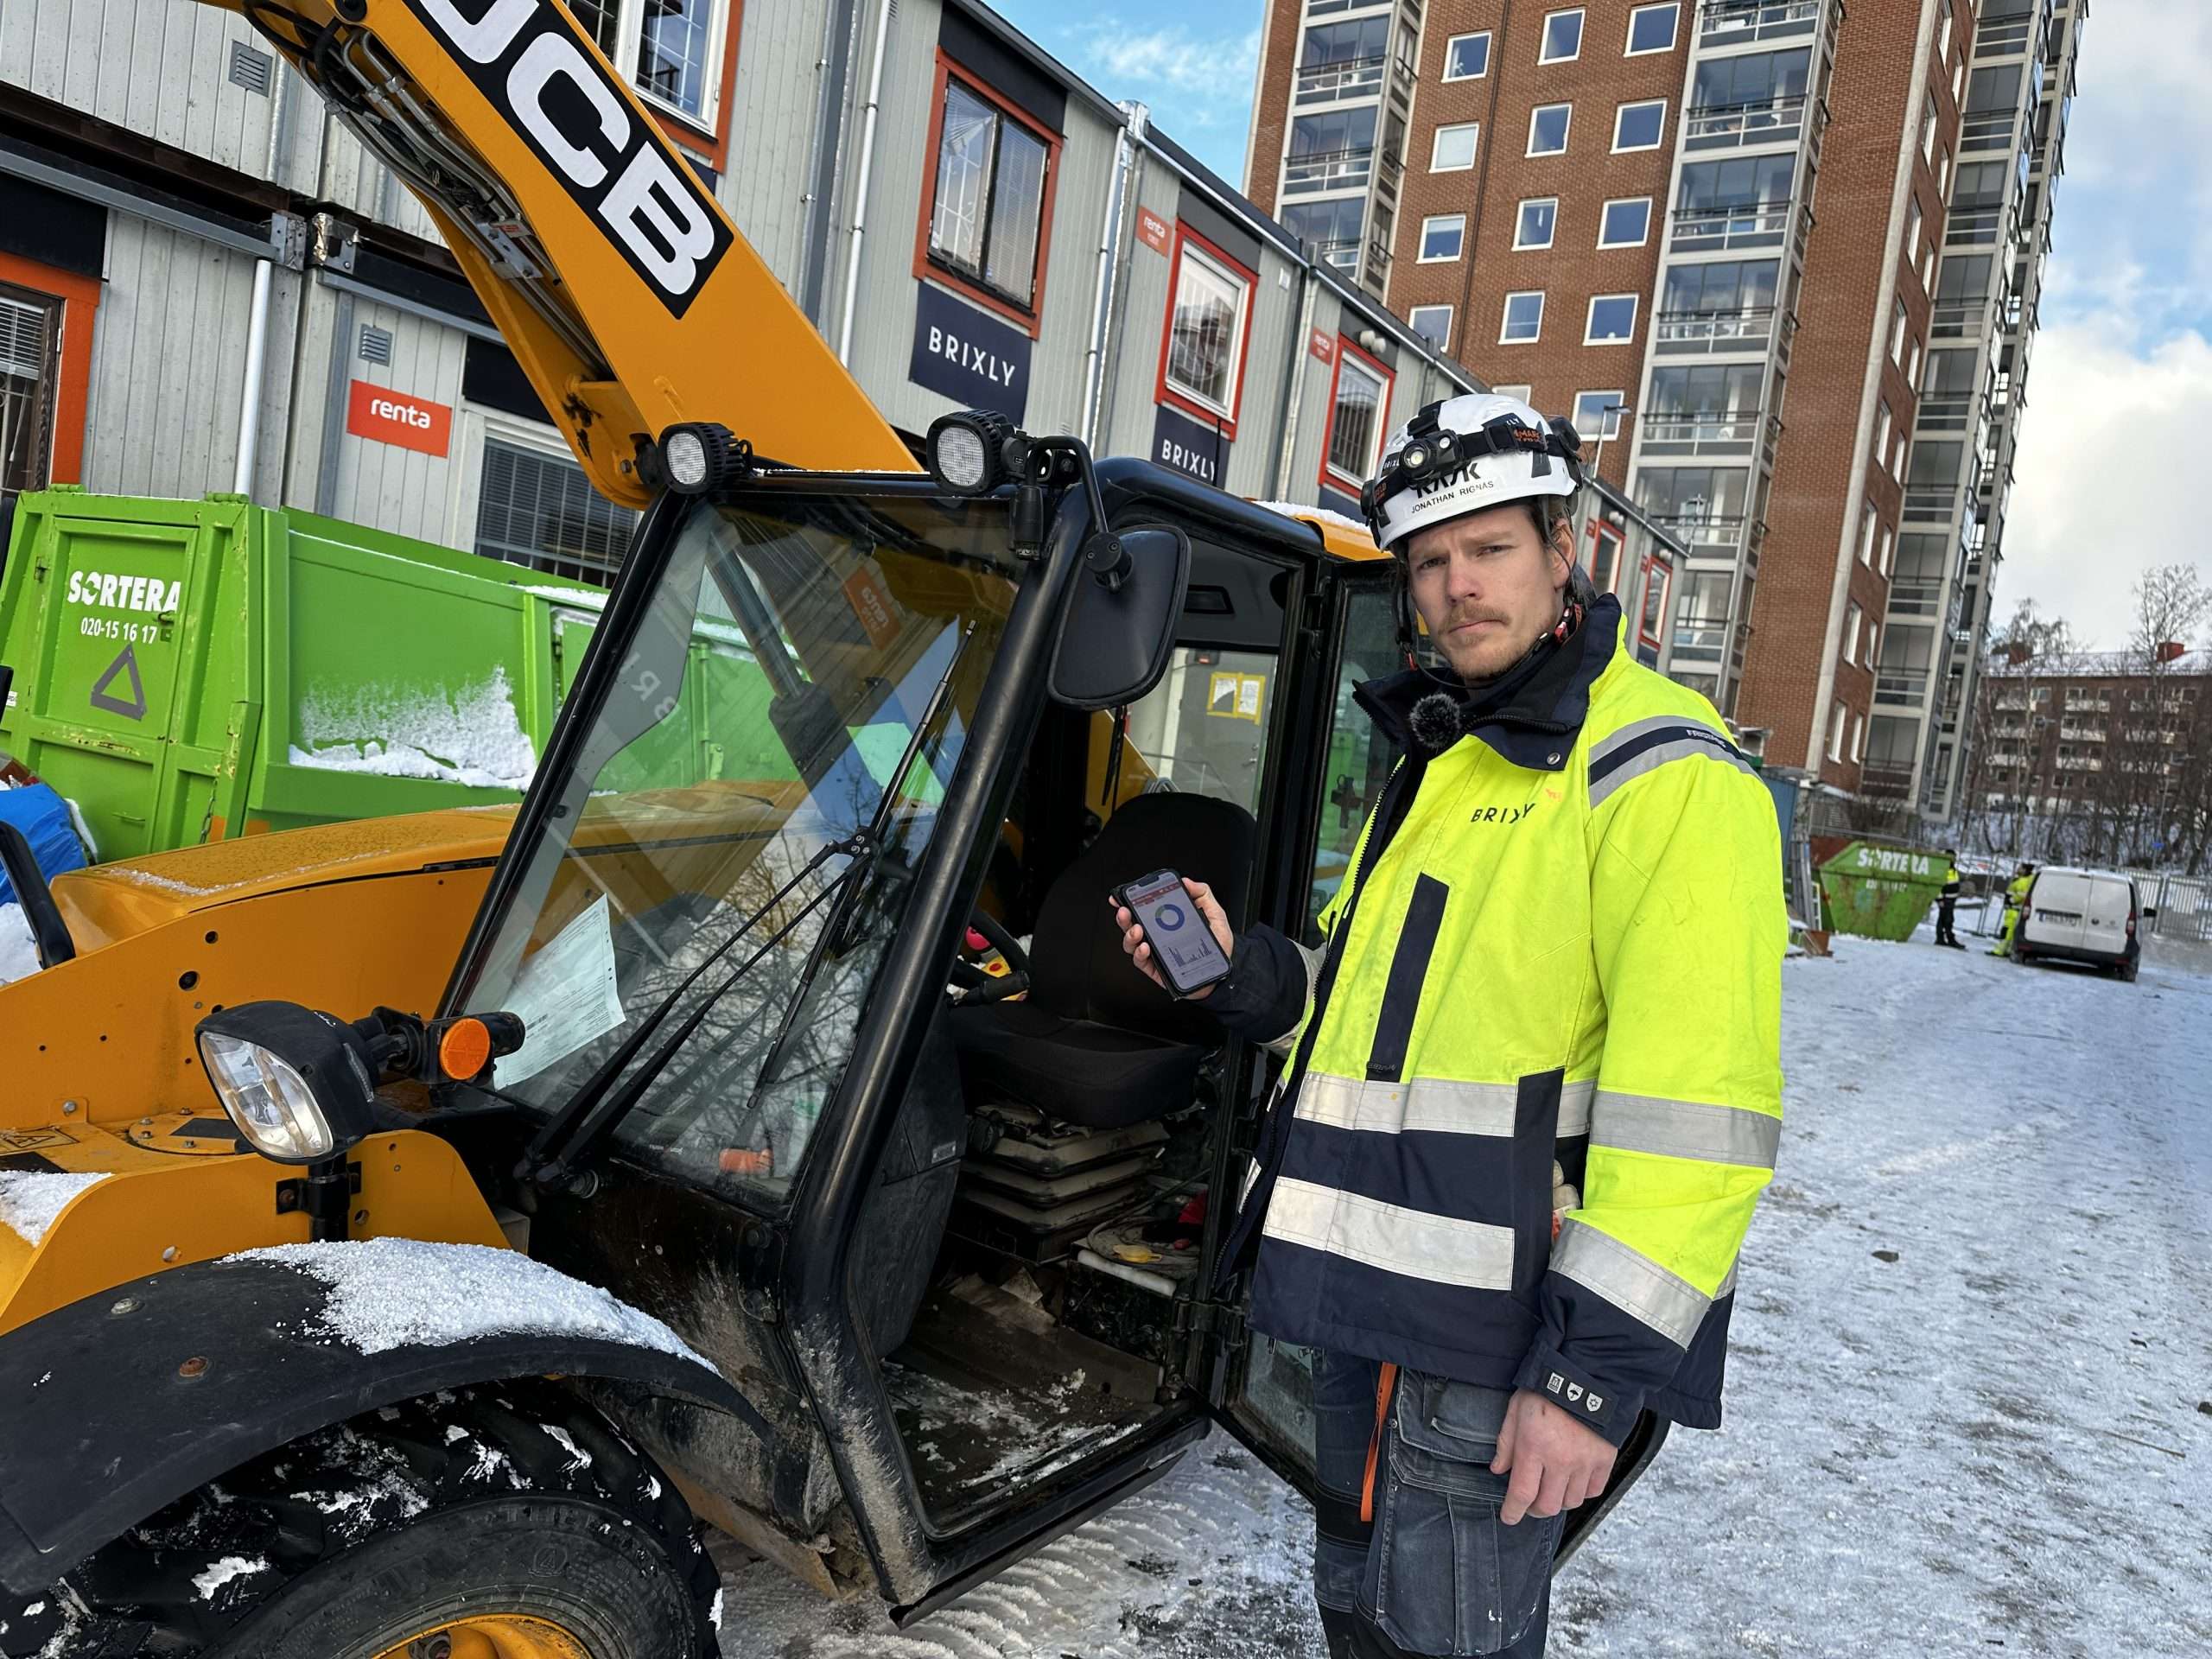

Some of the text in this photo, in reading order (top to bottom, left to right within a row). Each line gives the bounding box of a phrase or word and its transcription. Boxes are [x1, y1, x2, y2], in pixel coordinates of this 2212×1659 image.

[1143, 215, 1166, 239] renta
[928, 325, 1015, 387] BRIXLY
[370, 398, 431, 429] renta
[1411, 480, 1494, 513] JONATHAN RIGNAS
[67, 570, 182, 613] SORTERA
[80, 616, 157, 645] 020-15 16 17
